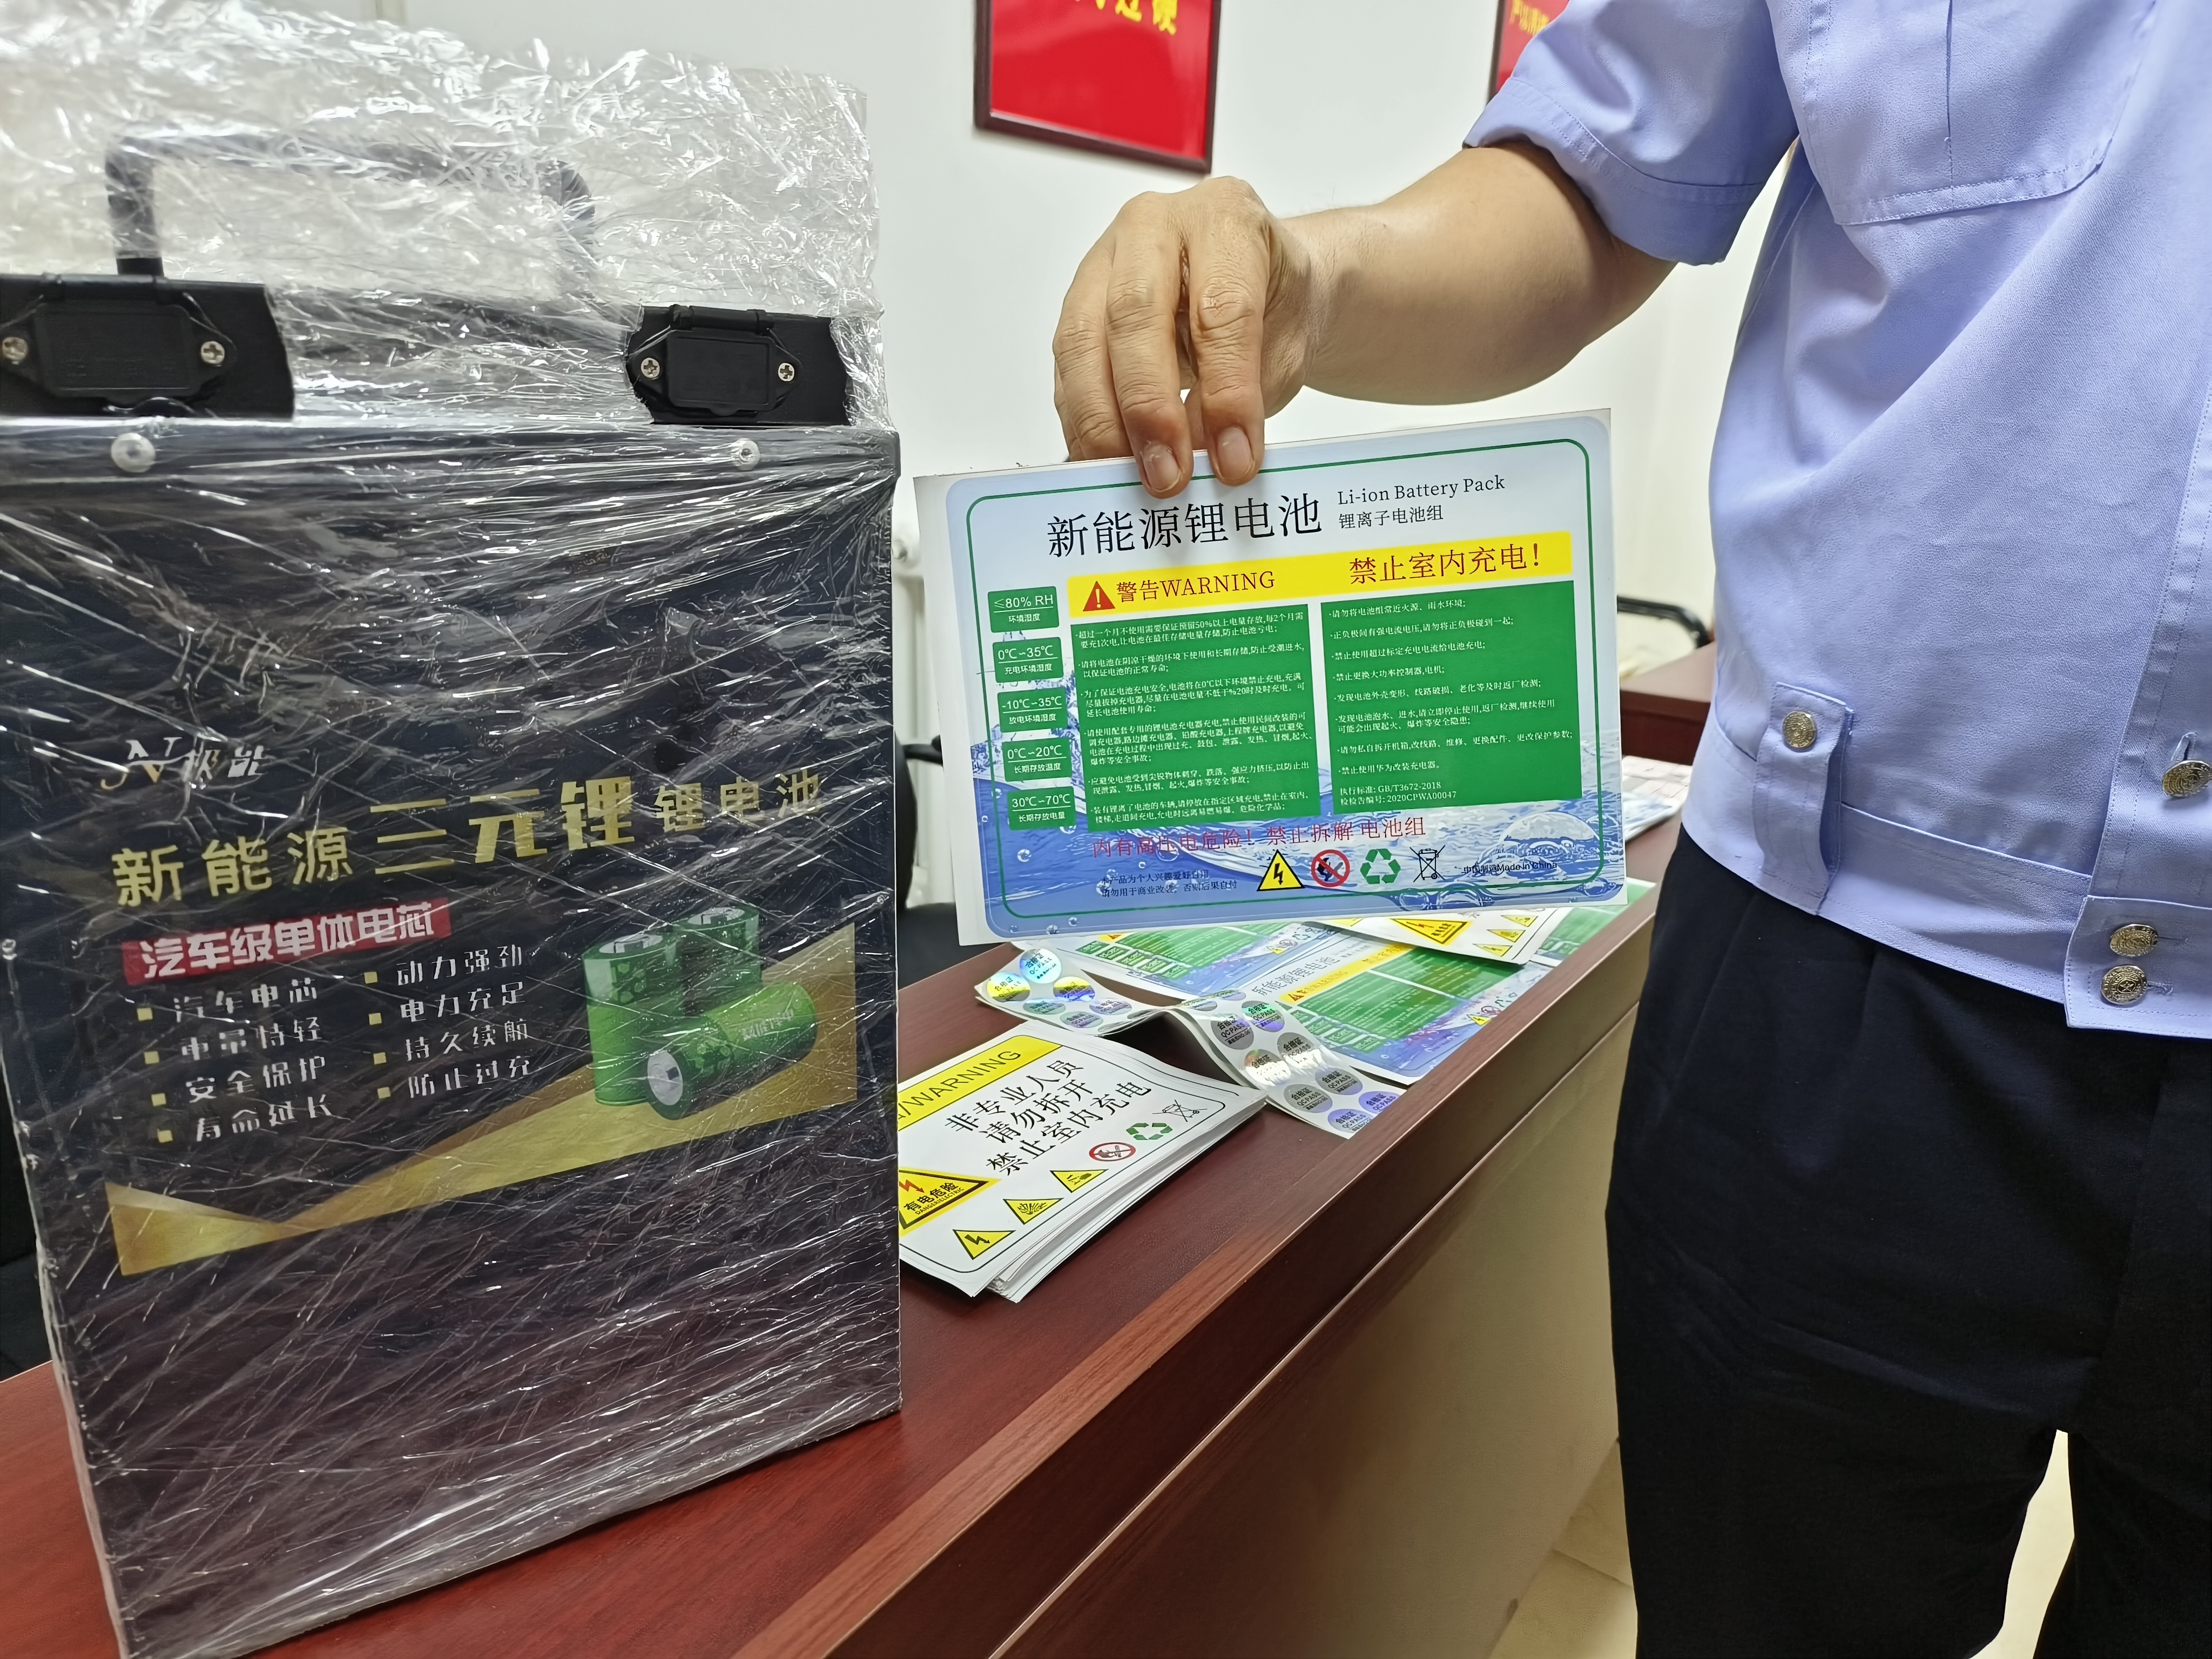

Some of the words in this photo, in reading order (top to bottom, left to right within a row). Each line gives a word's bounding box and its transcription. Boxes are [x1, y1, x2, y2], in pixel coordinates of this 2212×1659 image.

[1338, 488, 1389, 505] Li-ion
[1394, 481, 1459, 500] Battery
[1463, 475, 1506, 493] Pack
[1047, 493, 1322, 558] 新能源锂电池
[1338, 504, 1444, 530] 锂离子电池组
[1035, 594, 1054, 606] RH
[1116, 571, 1276, 603] 警告WARNING
[1014, 763, 1062, 774] 长期存放温度
[1019, 811, 1065, 822] 长期存放电量
[139, 901, 435, 979] 汽车级单体电芯
[396, 944, 522, 986] 动力强劲
[400, 981, 525, 1022] 电力充足
[406, 1018, 528, 1062] 持久续航
[186, 1056, 326, 1103] 安全保护
[408, 1055, 531, 1098] 防止过充
[945, 1060, 1084, 1131] 非专业人员
[979, 1079, 1093, 1144] 请勿拆开
[986, 1082, 1152, 1176] 禁止室内充电
[903, 1182, 959, 1211] 有电危险
